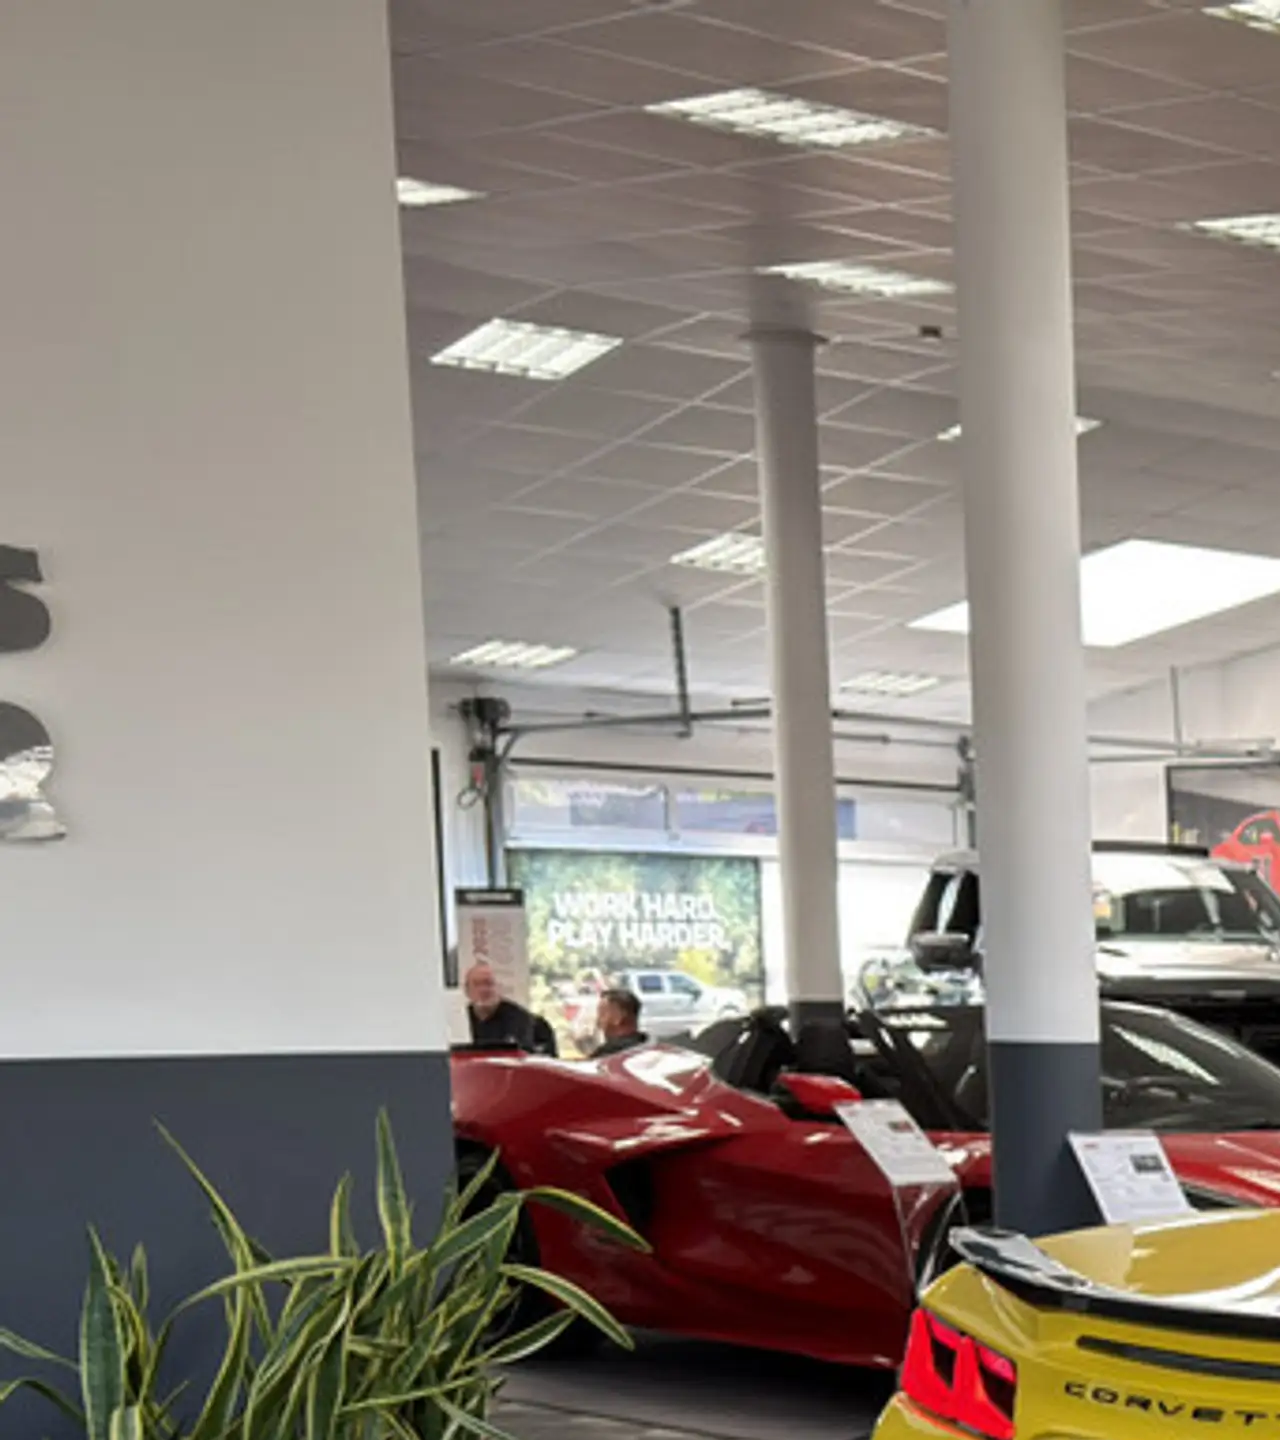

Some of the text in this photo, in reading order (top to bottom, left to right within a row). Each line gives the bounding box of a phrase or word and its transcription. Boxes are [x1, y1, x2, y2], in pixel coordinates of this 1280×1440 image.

[553, 892, 637, 918] WORK
[549, 921, 612, 948] PLAY
[618, 921, 731, 950] HARDER.
